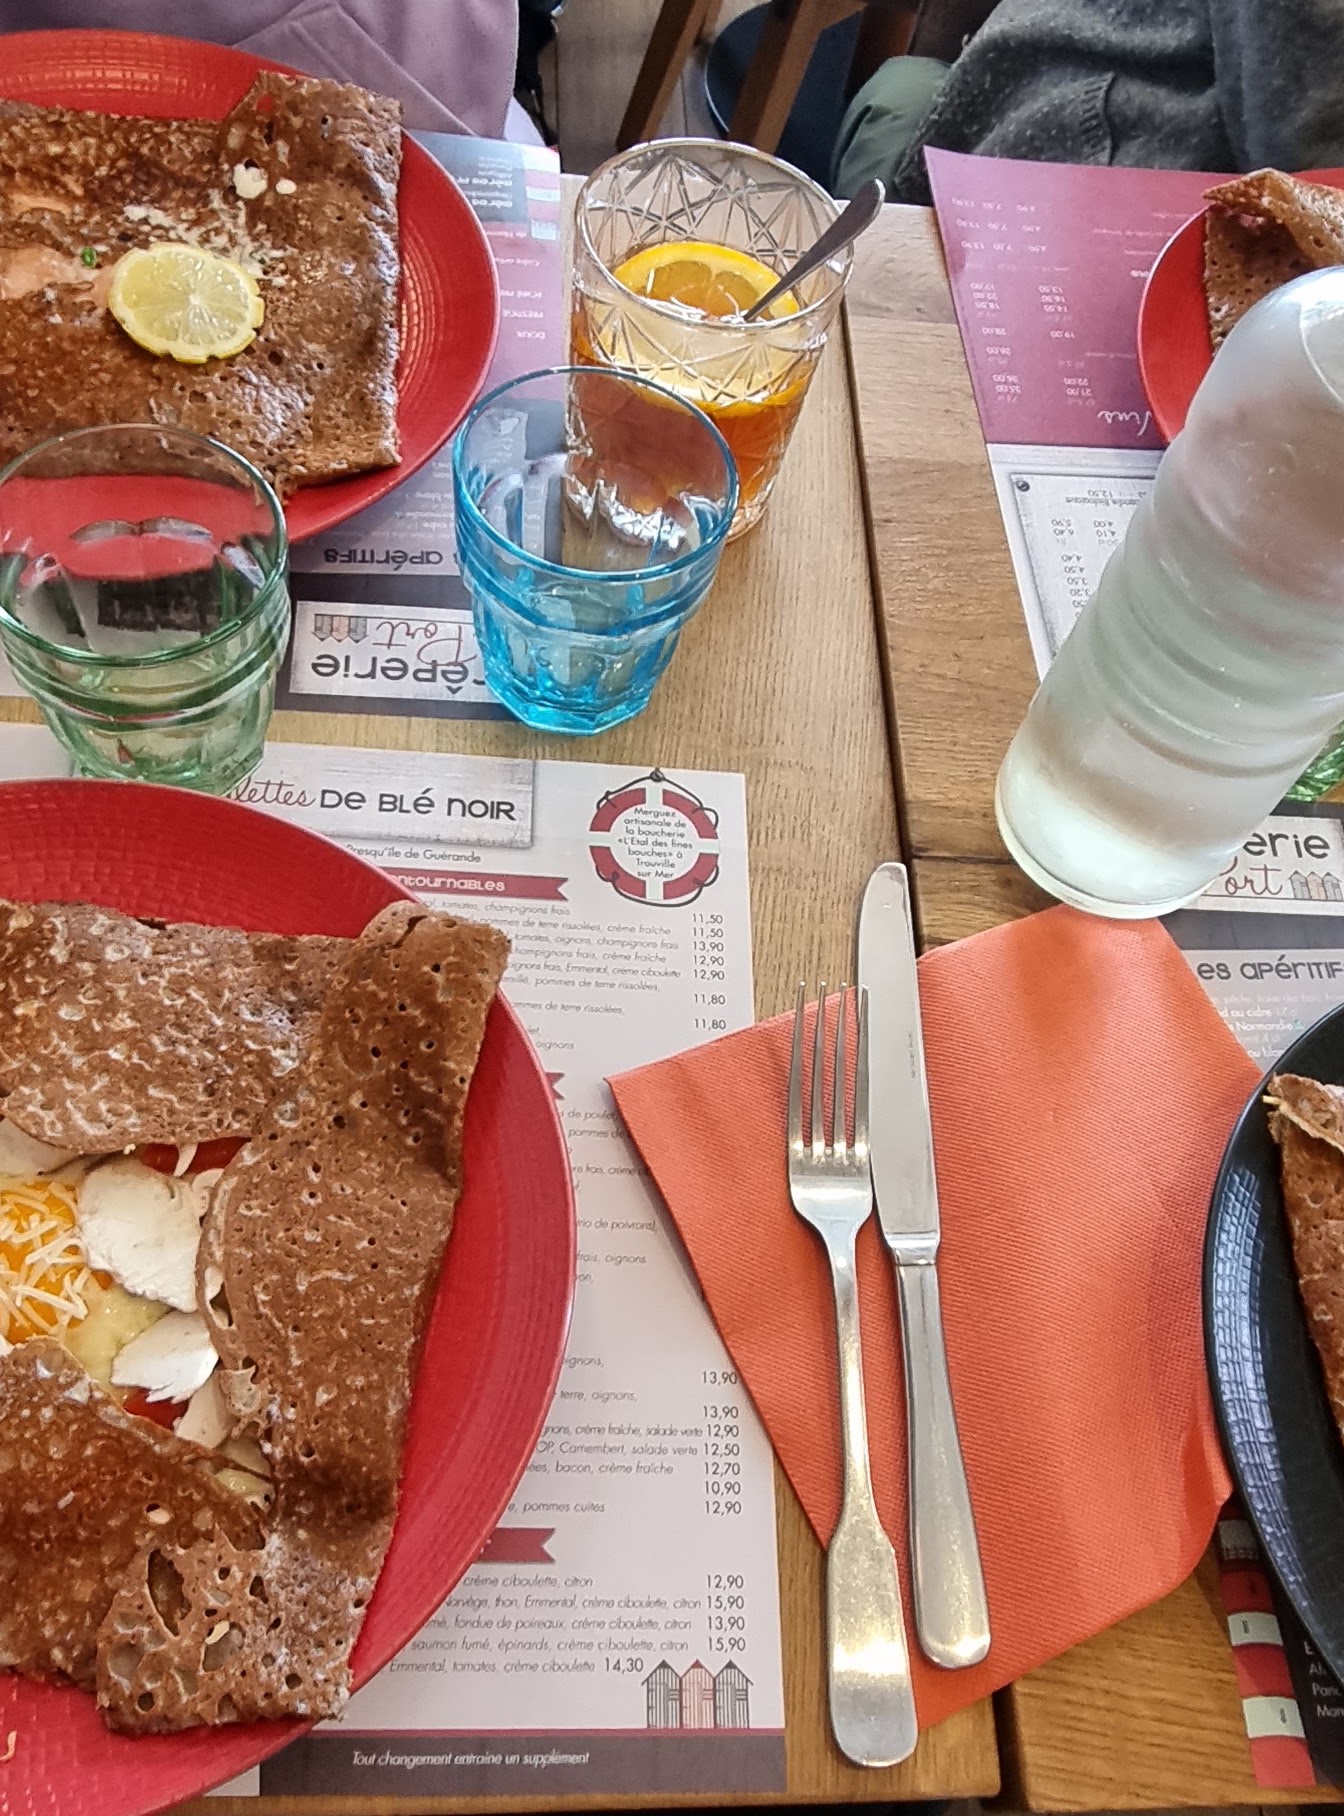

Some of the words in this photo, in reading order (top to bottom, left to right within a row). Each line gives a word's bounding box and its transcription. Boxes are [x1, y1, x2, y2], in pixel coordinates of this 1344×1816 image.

[373, 621, 477, 667] Port
[311, 653, 485, 695] êperie
[237, 778, 316, 807] lettes
[634, 807, 676, 818] Merguez
[624, 818, 671, 826] artisanale
[674, 819, 686, 828] de
[626, 826, 634, 835] la
[638, 827, 685, 838] boucherie
[652, 838, 668, 846] des
[671, 838, 692, 849] fines
[405, 849, 419, 859] de
[423, 849, 481, 863] Guérande
[677, 850, 682, 858] à
[636, 858, 675, 868] Trouville
[655, 870, 674, 878] Mer
[693, 913, 723, 925] 11,50
[693, 927, 723, 939] 11,50
[693, 941, 724, 953] 13,90
[693, 956, 724, 968] 12,90
[693, 969, 725, 982] 12,90
[1197, 962, 1231, 980] es
[694, 994, 726, 1006] 11,80
[695, 1019, 726, 1031] 11,80
[702, 1372, 738, 1386] 13,90
[703, 1406, 739, 1420] 13,90
[707, 1424, 740, 1439] 12,90
[704, 1443, 740, 1458] 12,50
[704, 1463, 740, 1477] 12,70
[705, 1481, 741, 1496] 10,90
[523, 1502, 570, 1514] pommes
[705, 1501, 742, 1515] 12,90
[706, 1575, 744, 1590] 12,90
[706, 1596, 745, 1611] 15,90
[707, 1616, 745, 1631] 13,90
[707, 1637, 746, 1653] 15,90
[605, 1658, 644, 1674] 14,30
[353, 1751, 377, 1764] Tout
[378, 1751, 451, 1768] changement
[506, 1754, 520, 1763] un
[523, 1751, 589, 1768] supplément
